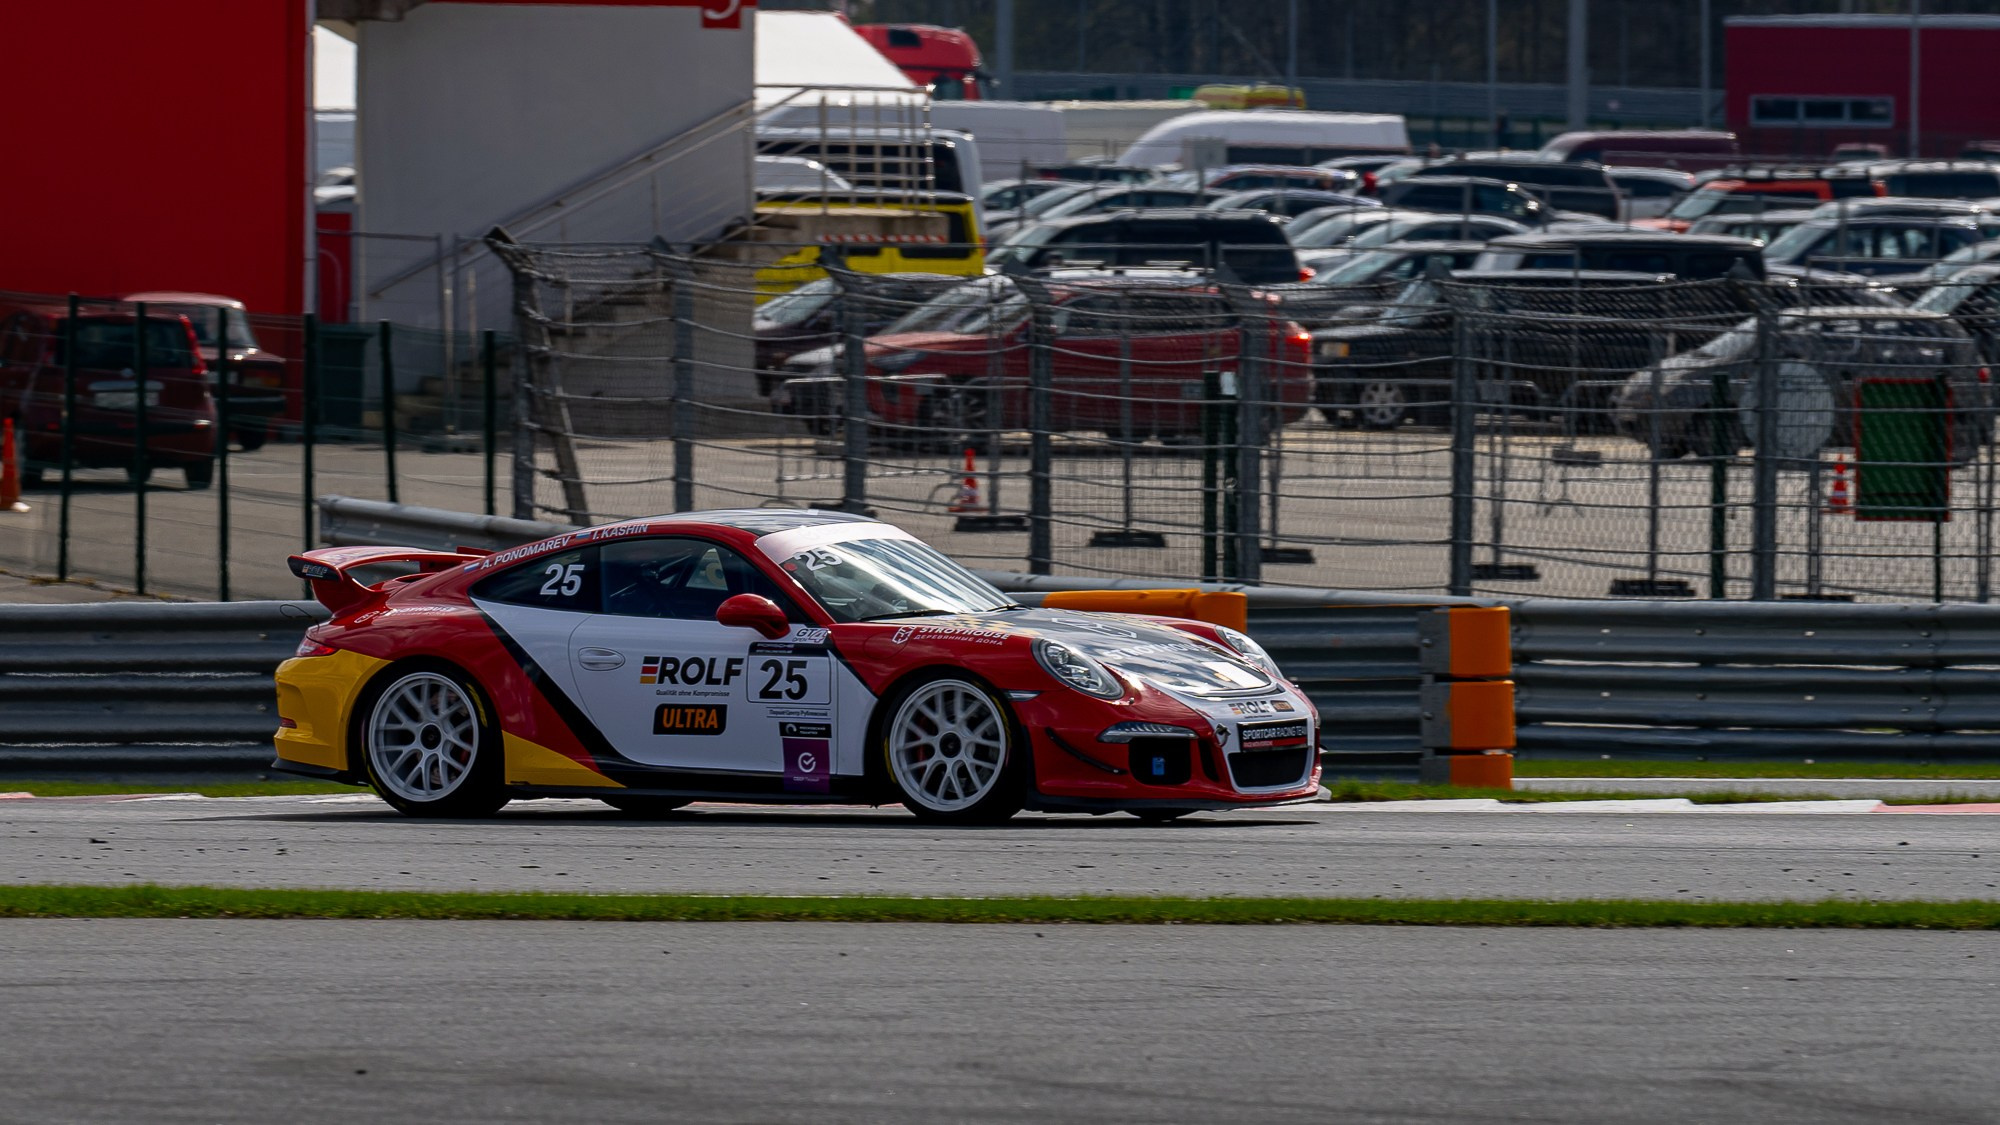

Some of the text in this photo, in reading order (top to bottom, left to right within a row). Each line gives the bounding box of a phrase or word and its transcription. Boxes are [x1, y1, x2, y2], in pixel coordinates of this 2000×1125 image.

[601, 524, 650, 538] KASHIN
[480, 536, 572, 570] A. PONOMAREV
[793, 547, 843, 571] 25
[540, 564, 585, 596] 25
[914, 634, 974, 642] ДЕРЕВЯННЫЕ
[919, 626, 1011, 640] STROYHOUSE
[657, 656, 744, 685] ROLF
[759, 659, 808, 700] 25
[662, 708, 718, 729] ULTRA
[1242, 728, 1277, 740] SPORTCAR
